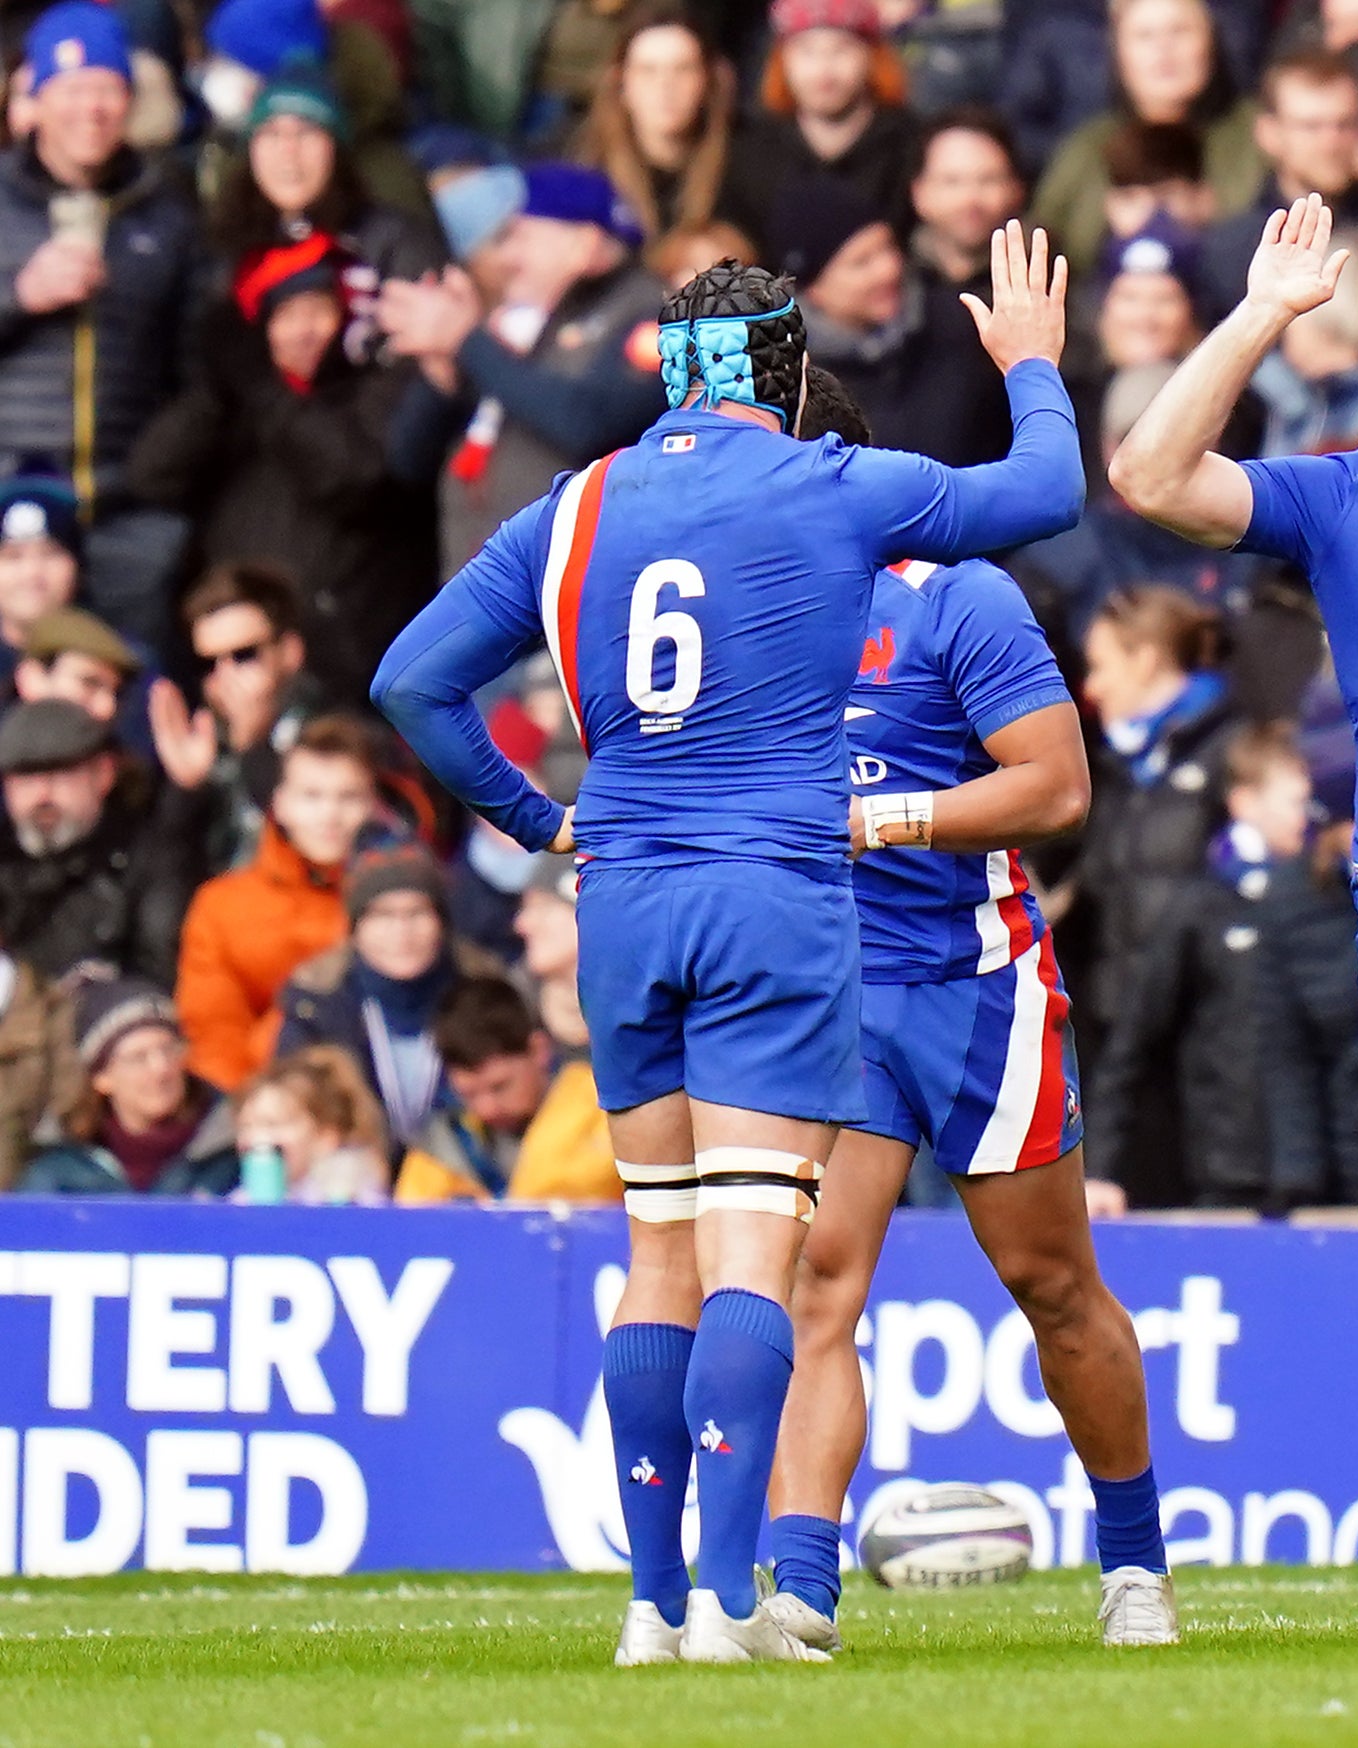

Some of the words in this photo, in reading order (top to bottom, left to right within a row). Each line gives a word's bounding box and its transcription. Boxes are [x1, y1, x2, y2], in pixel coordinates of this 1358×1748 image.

[626, 558, 705, 716] 6
[0, 1251, 455, 1417] TERY
[0, 1426, 369, 1576] DED
